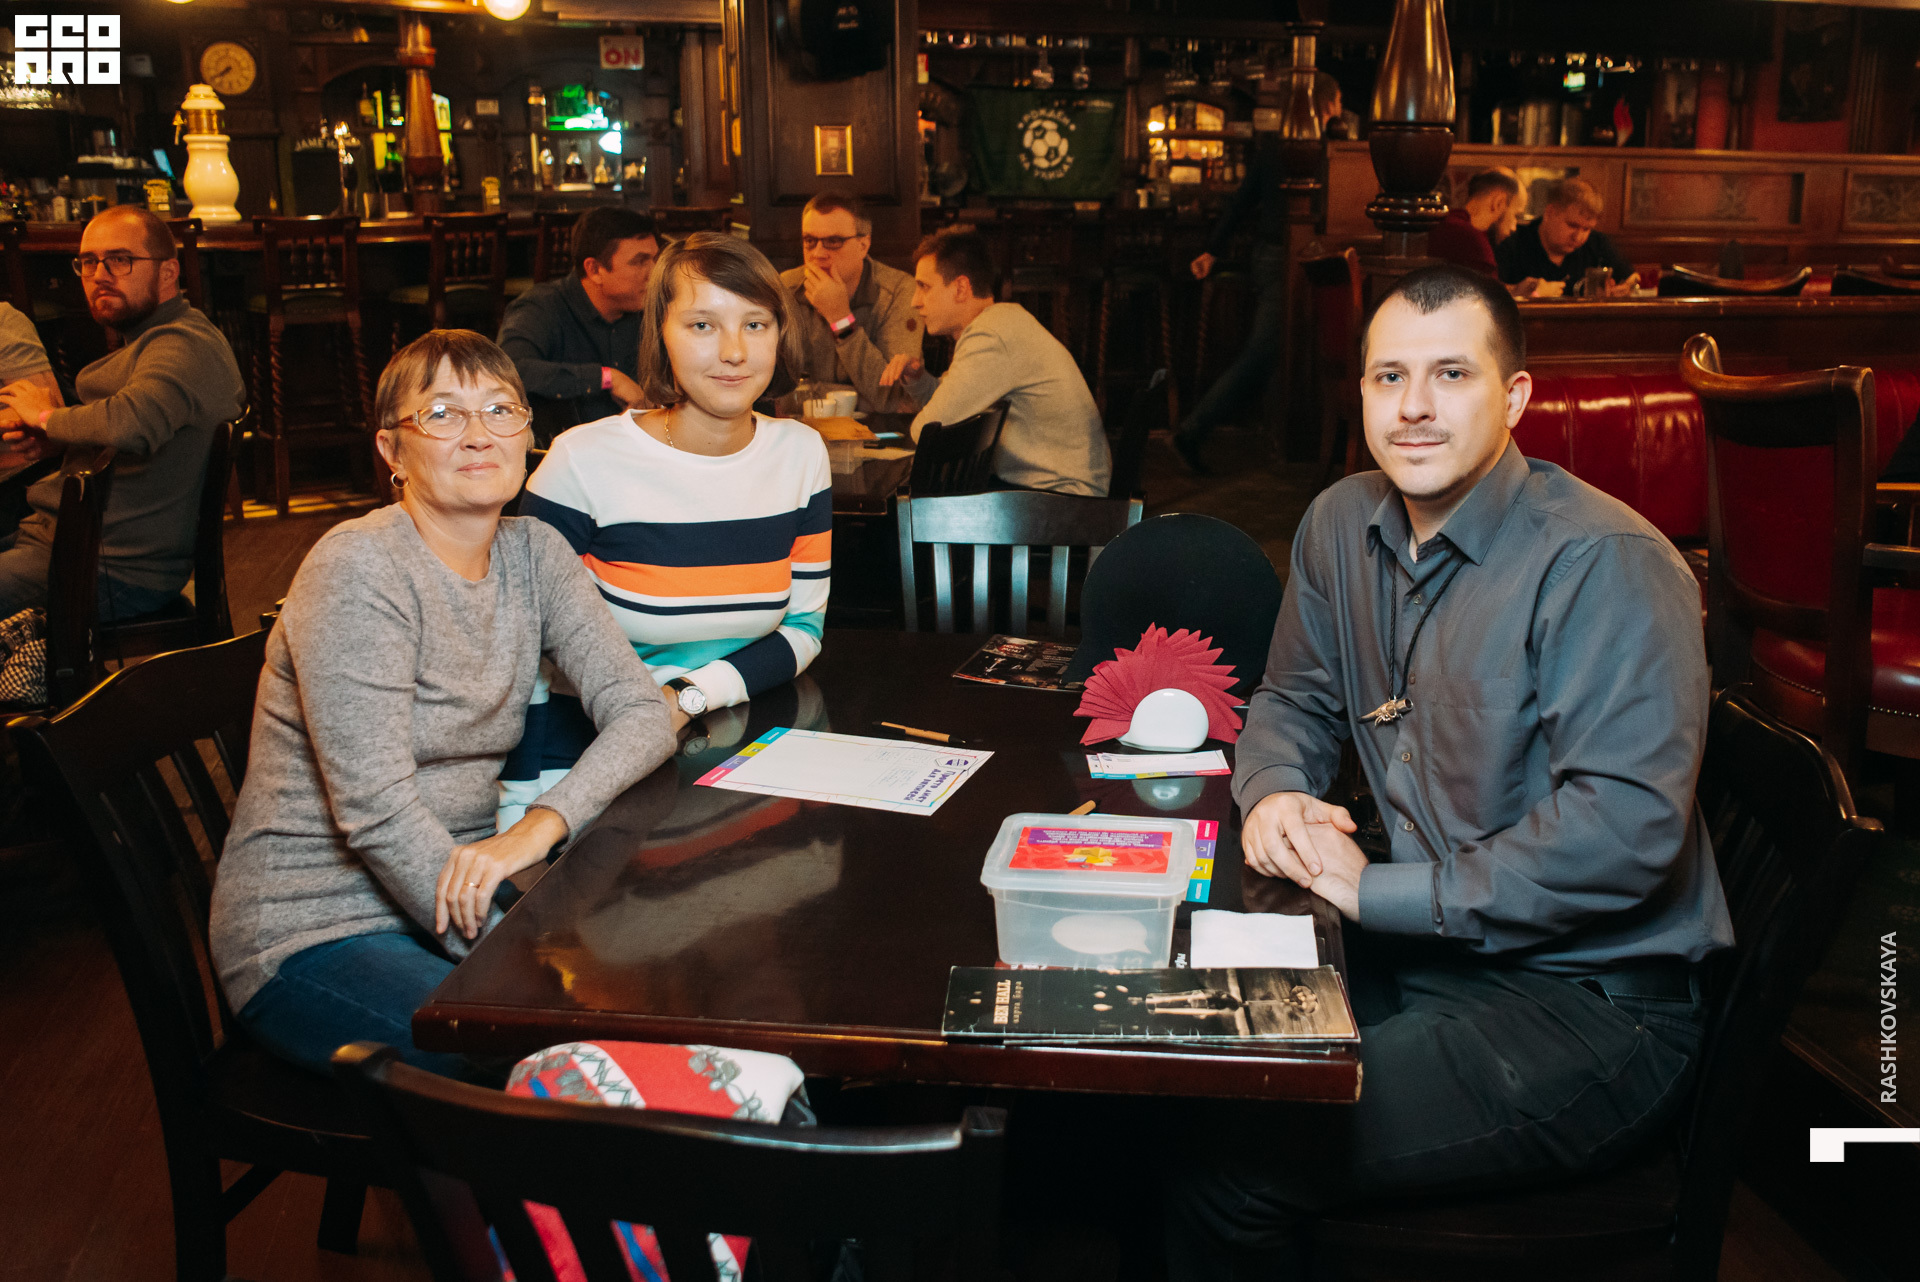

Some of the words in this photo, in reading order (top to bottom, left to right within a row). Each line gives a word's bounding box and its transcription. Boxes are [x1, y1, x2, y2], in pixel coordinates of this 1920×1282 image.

[605, 48, 640, 65] ON
[996, 979, 1011, 1004] HALL
[993, 1004, 1009, 1024] BEN
